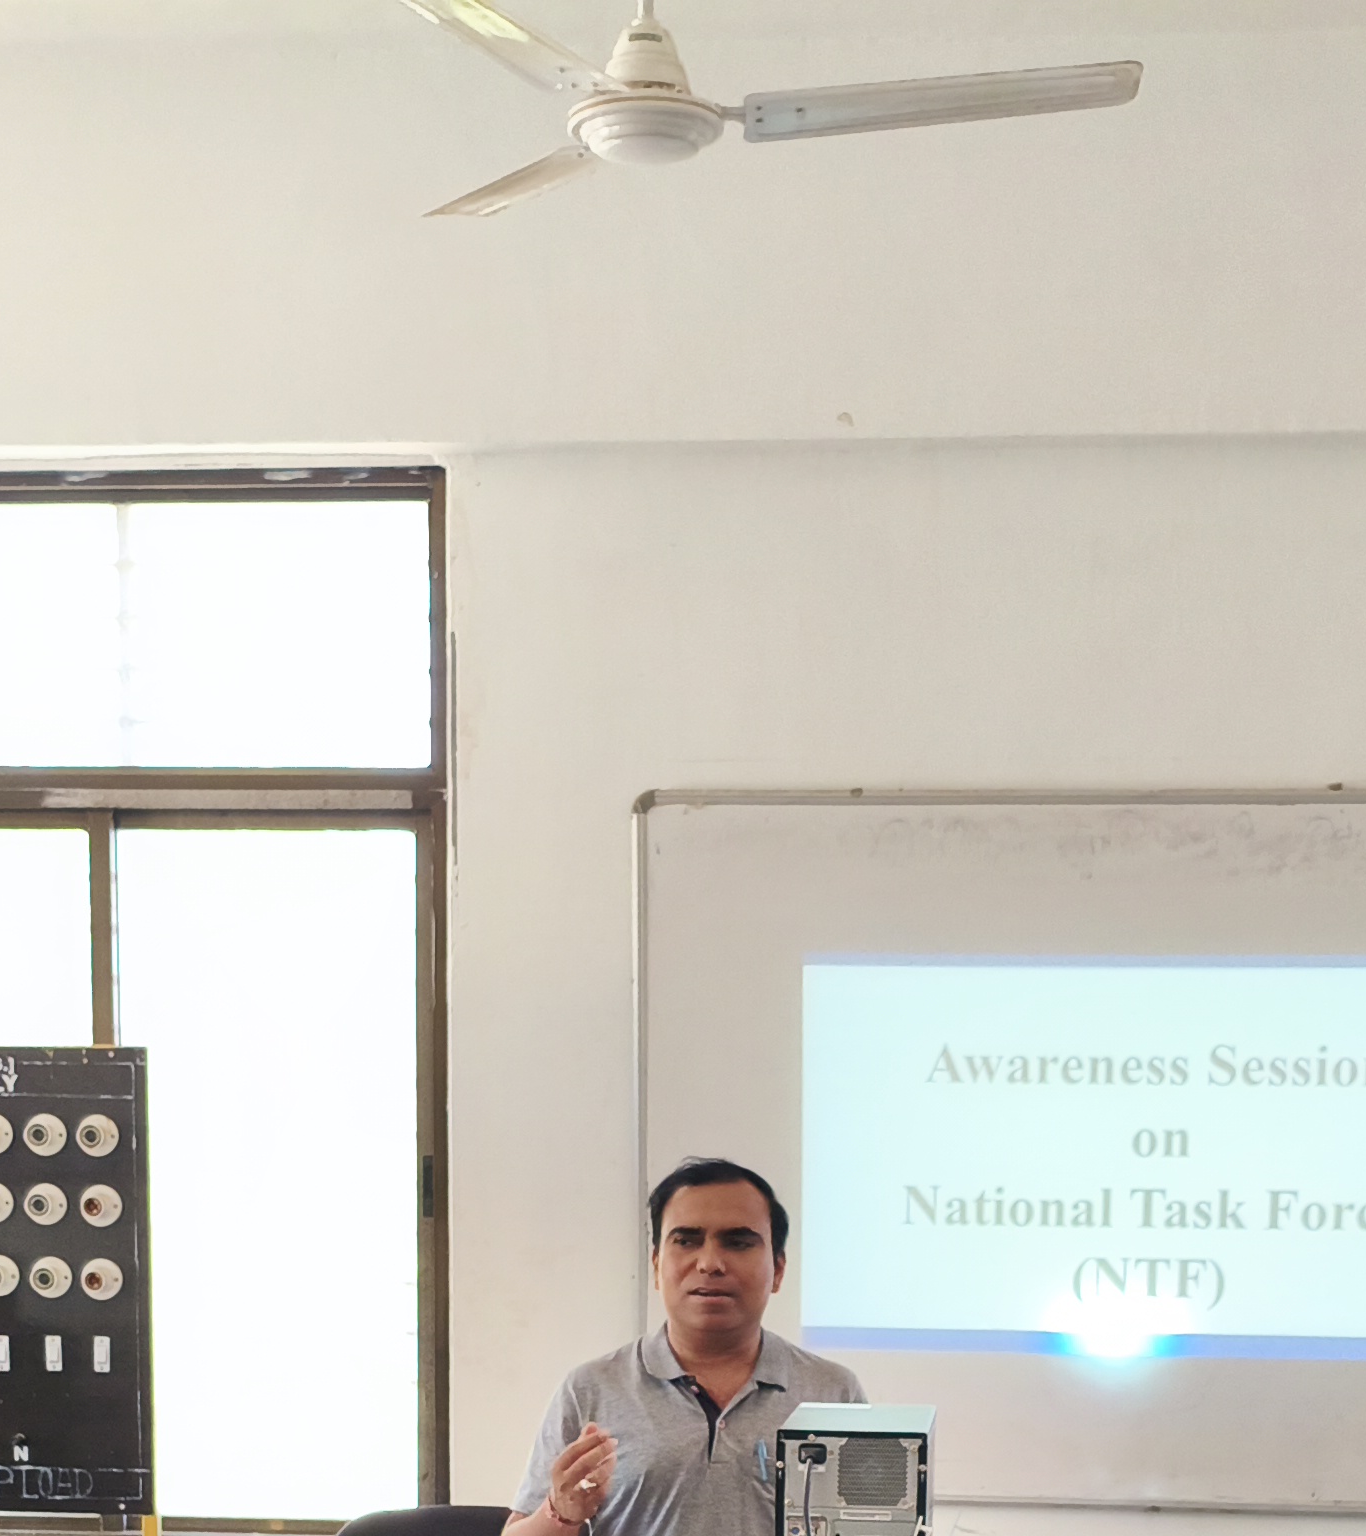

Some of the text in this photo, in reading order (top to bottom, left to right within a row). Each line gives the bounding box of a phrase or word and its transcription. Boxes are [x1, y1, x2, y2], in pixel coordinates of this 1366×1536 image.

[924, 1042, 1191, 1088] Awareness
[1131, 1127, 1191, 1159] on
[901, 1184, 1113, 1230] National
[1129, 1187, 1247, 1231] Task
[1071, 1255, 1227, 1311] (NTF)
[12, 1445, 30, 1462] N
[19, 1464, 94, 1499] LOAD
